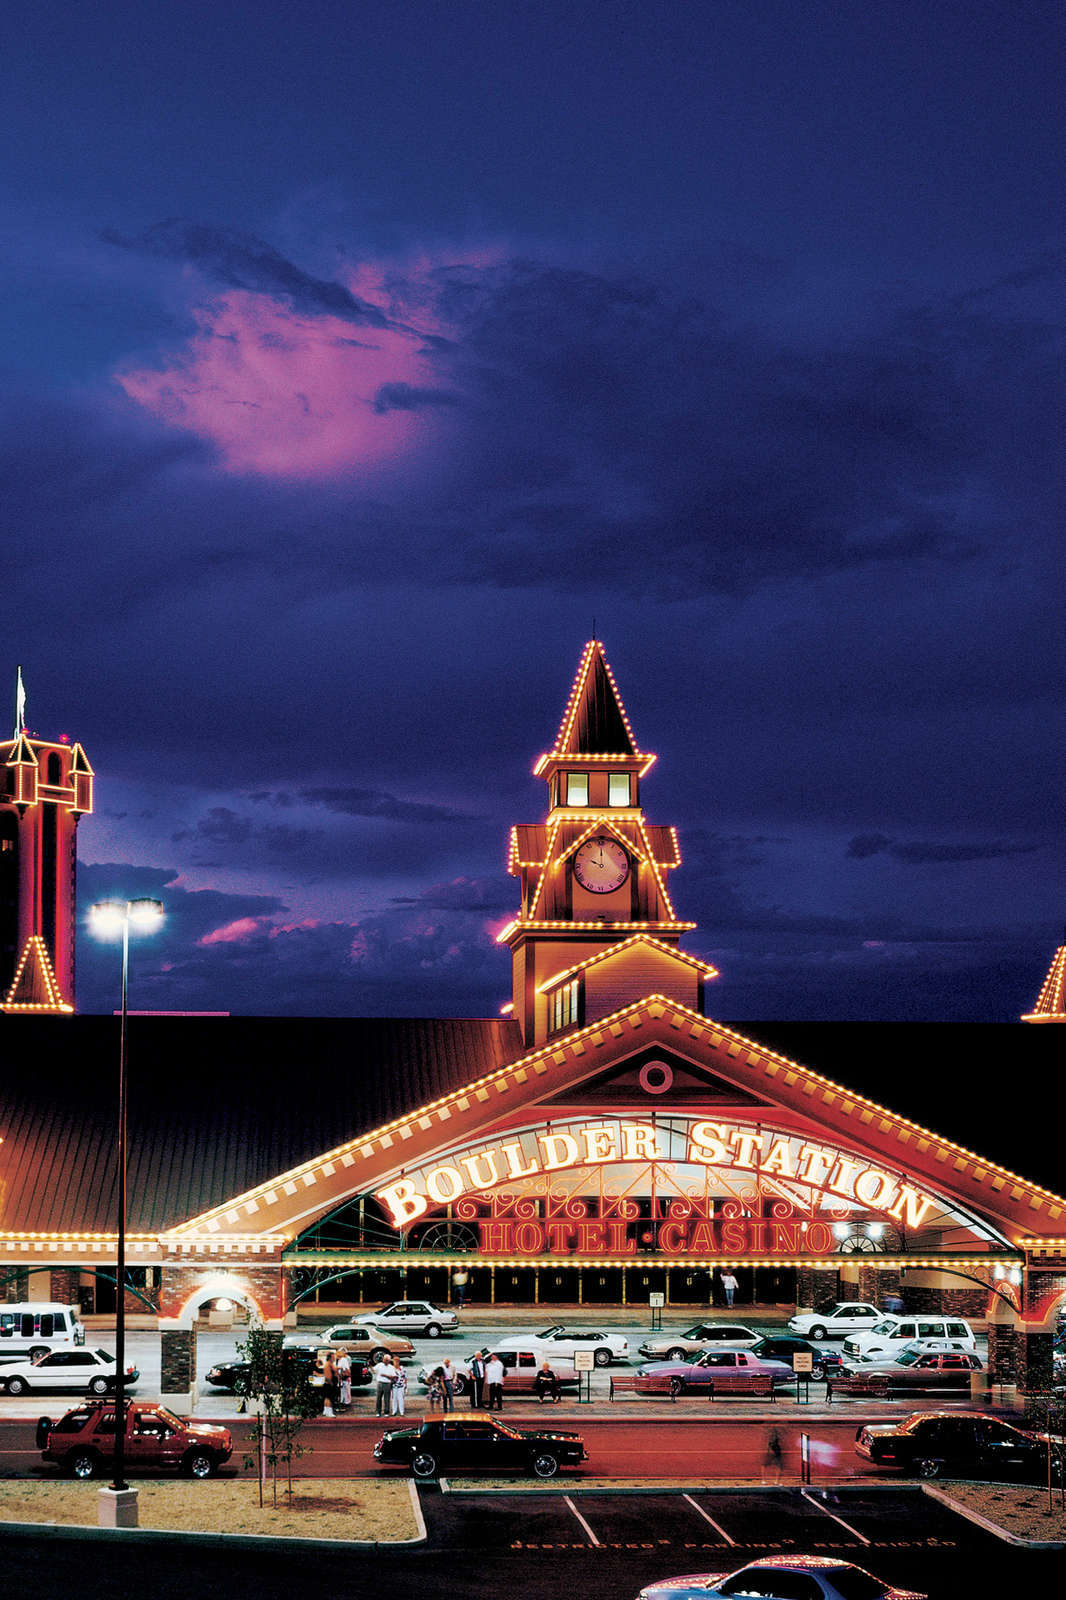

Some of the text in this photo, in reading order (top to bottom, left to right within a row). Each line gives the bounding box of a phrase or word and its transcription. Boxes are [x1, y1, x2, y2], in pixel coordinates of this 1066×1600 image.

[376, 1120, 936, 1229] BOULDER STATION
[479, 1221, 834, 1254] HOTEL CASINO
